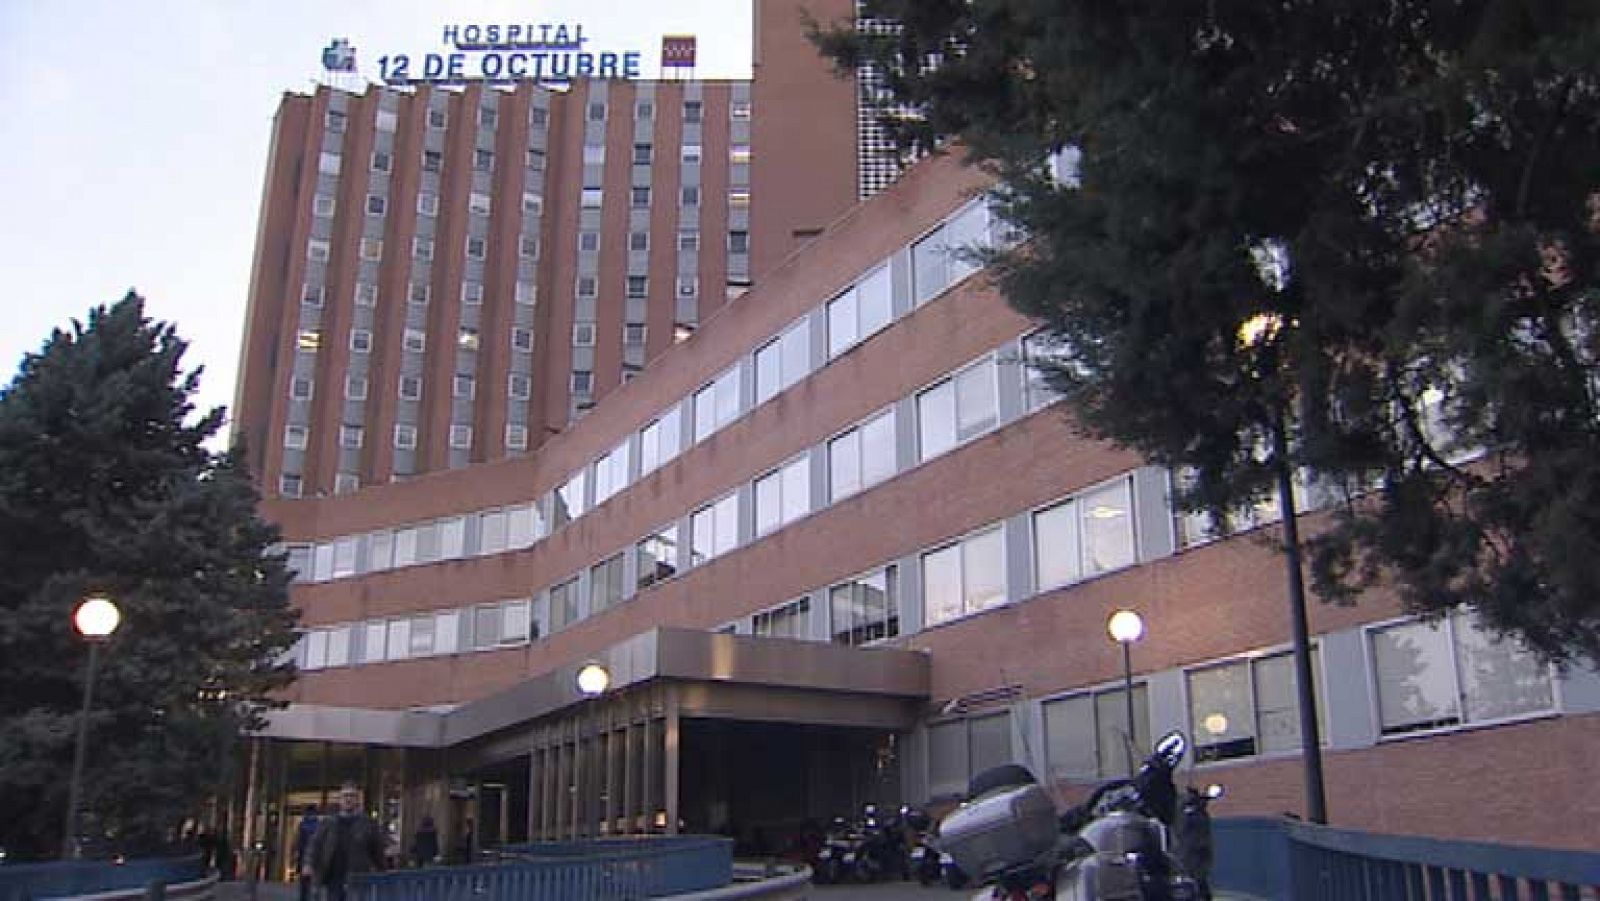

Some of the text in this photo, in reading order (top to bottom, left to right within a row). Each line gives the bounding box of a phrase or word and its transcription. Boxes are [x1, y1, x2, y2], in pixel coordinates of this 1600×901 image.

[442, 24, 588, 45] HOSPITAL
[377, 53, 641, 79] 12 DE OCTUBRE
